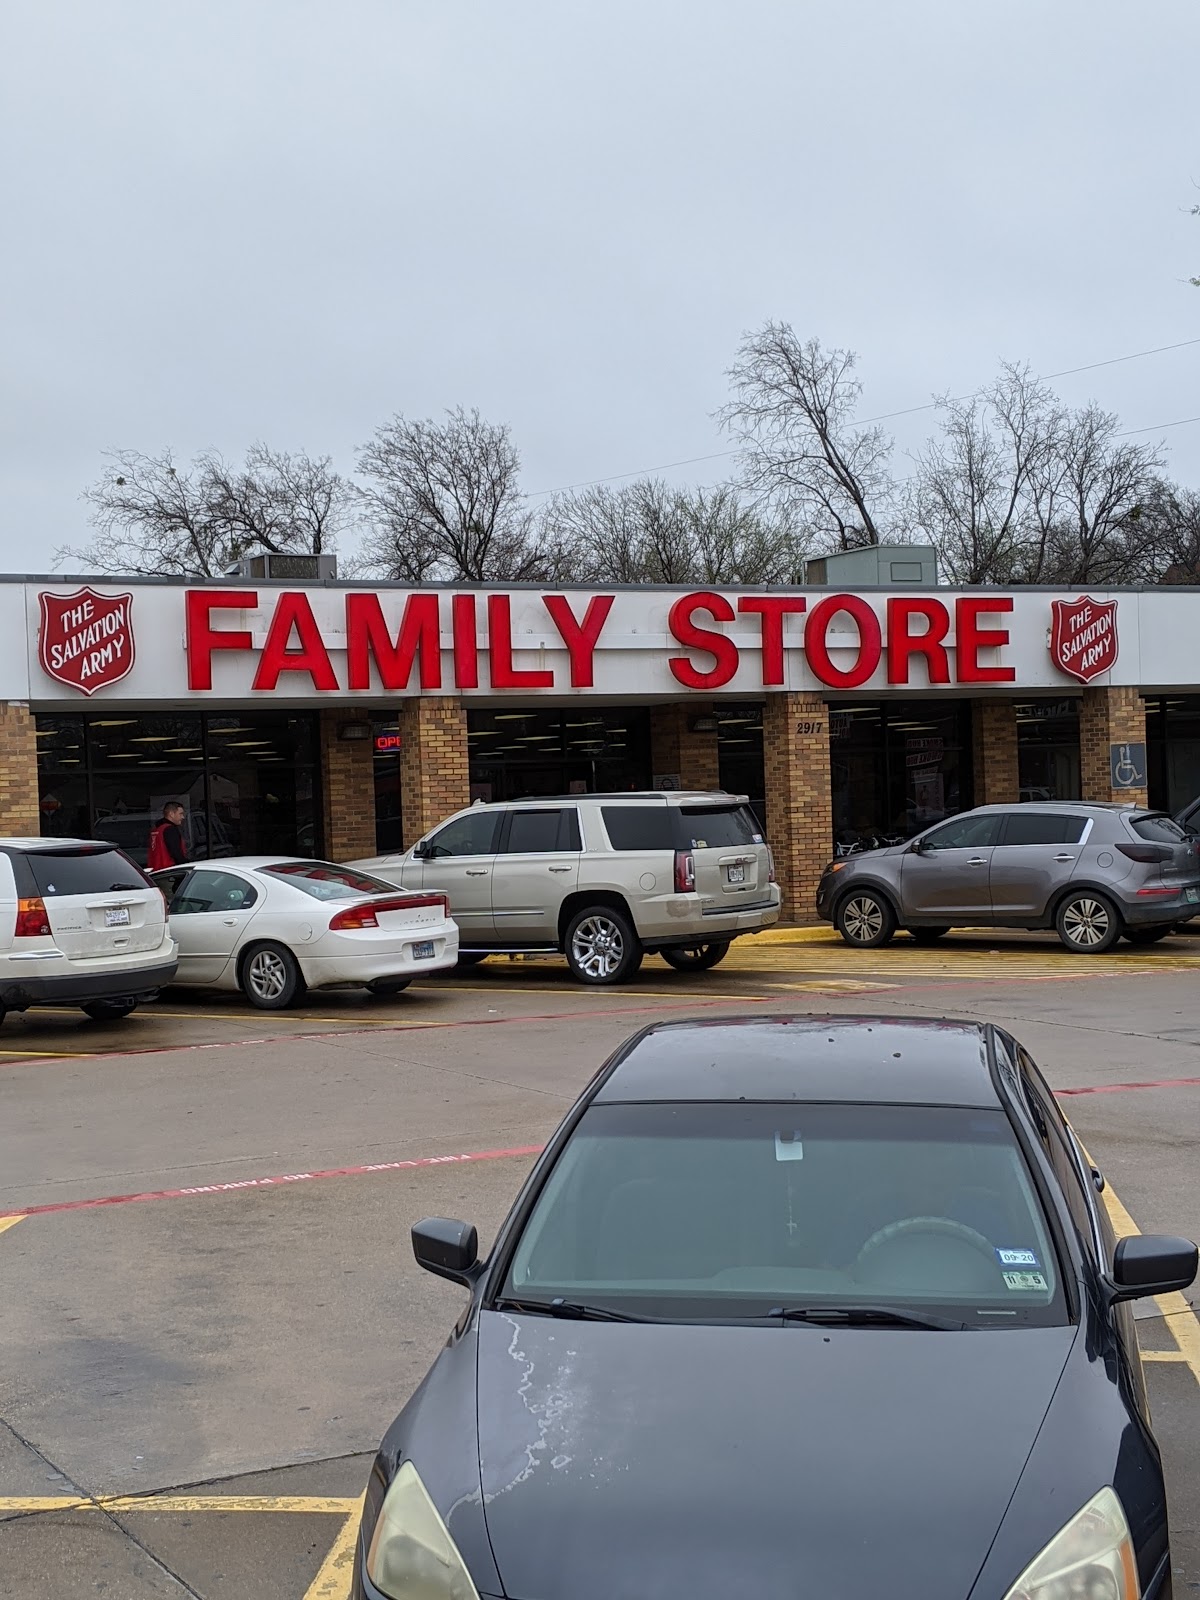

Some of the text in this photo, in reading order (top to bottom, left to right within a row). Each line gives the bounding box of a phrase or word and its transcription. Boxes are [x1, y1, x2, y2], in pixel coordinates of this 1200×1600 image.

[60, 599, 95, 632] THE
[1062, 609, 1112, 662] SALVATION
[1069, 605, 1093, 633] THE
[51, 604, 125, 670] SALVATION
[80, 634, 125, 681] ARMY
[185, 590, 1016, 690] FAMILY STORE
[1080, 635, 1112, 671] ARMY
[796, 722, 823, 735] 2917
[180, 1153, 472, 1195] FIRE LANE NO PARKING
